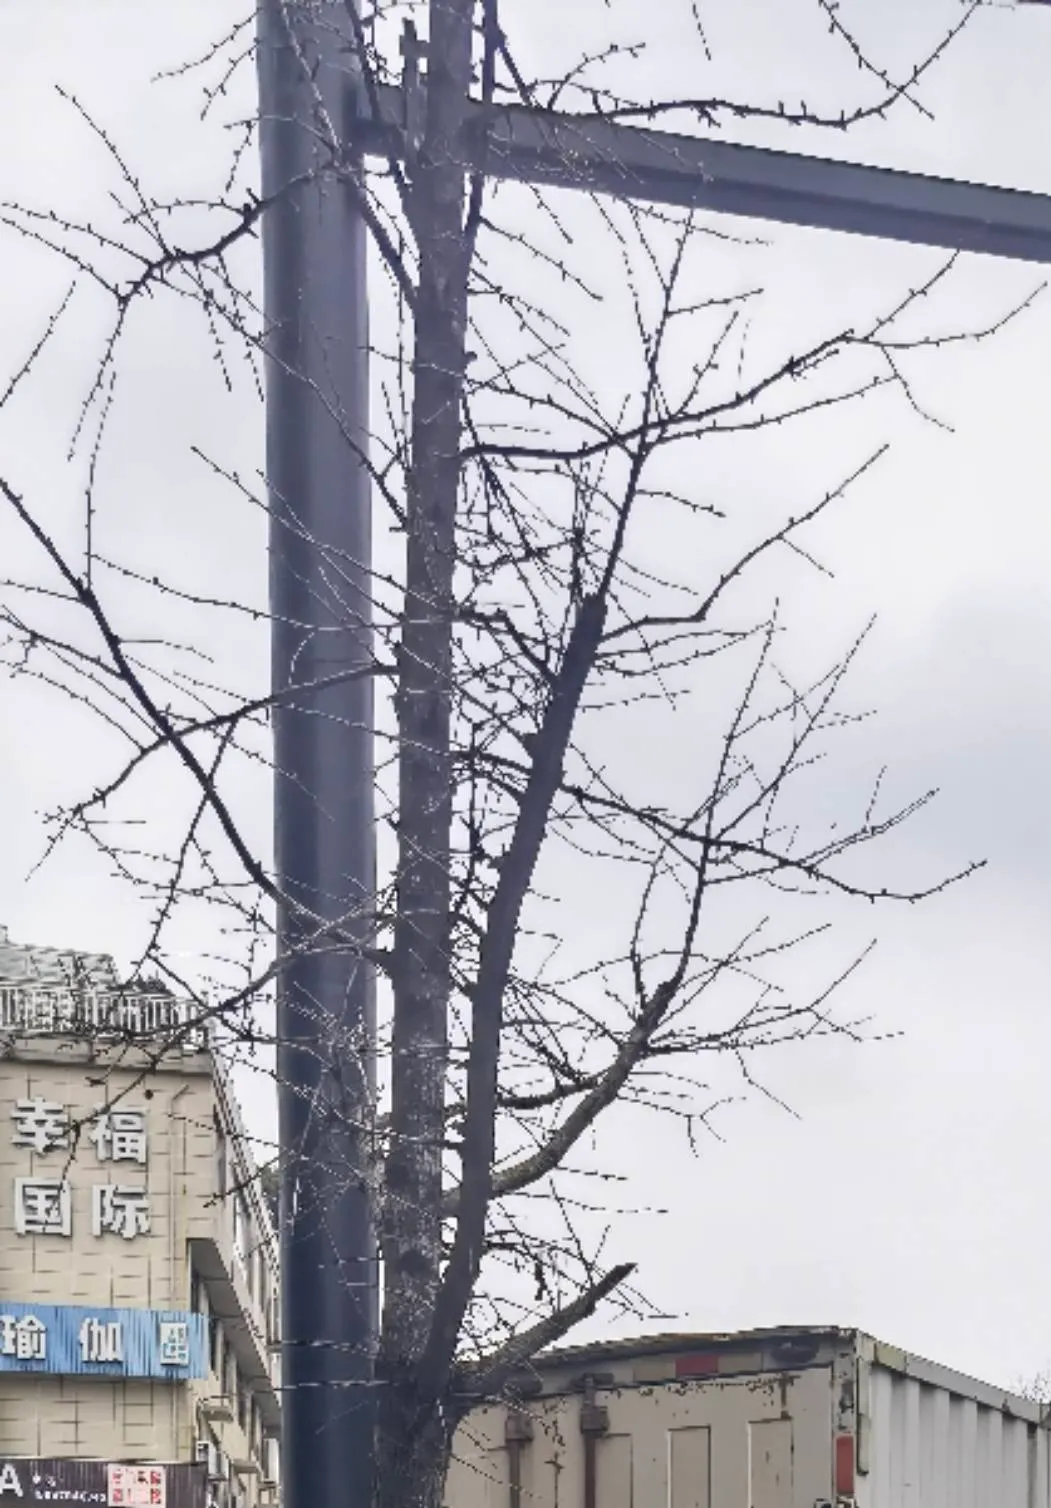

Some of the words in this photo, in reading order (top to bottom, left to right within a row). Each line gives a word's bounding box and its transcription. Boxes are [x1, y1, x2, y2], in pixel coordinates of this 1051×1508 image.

[10, 1096, 148, 1164] 幸福
[14, 1177, 151, 1240] 国际
[0, 1313, 124, 1362] 瑜伽
